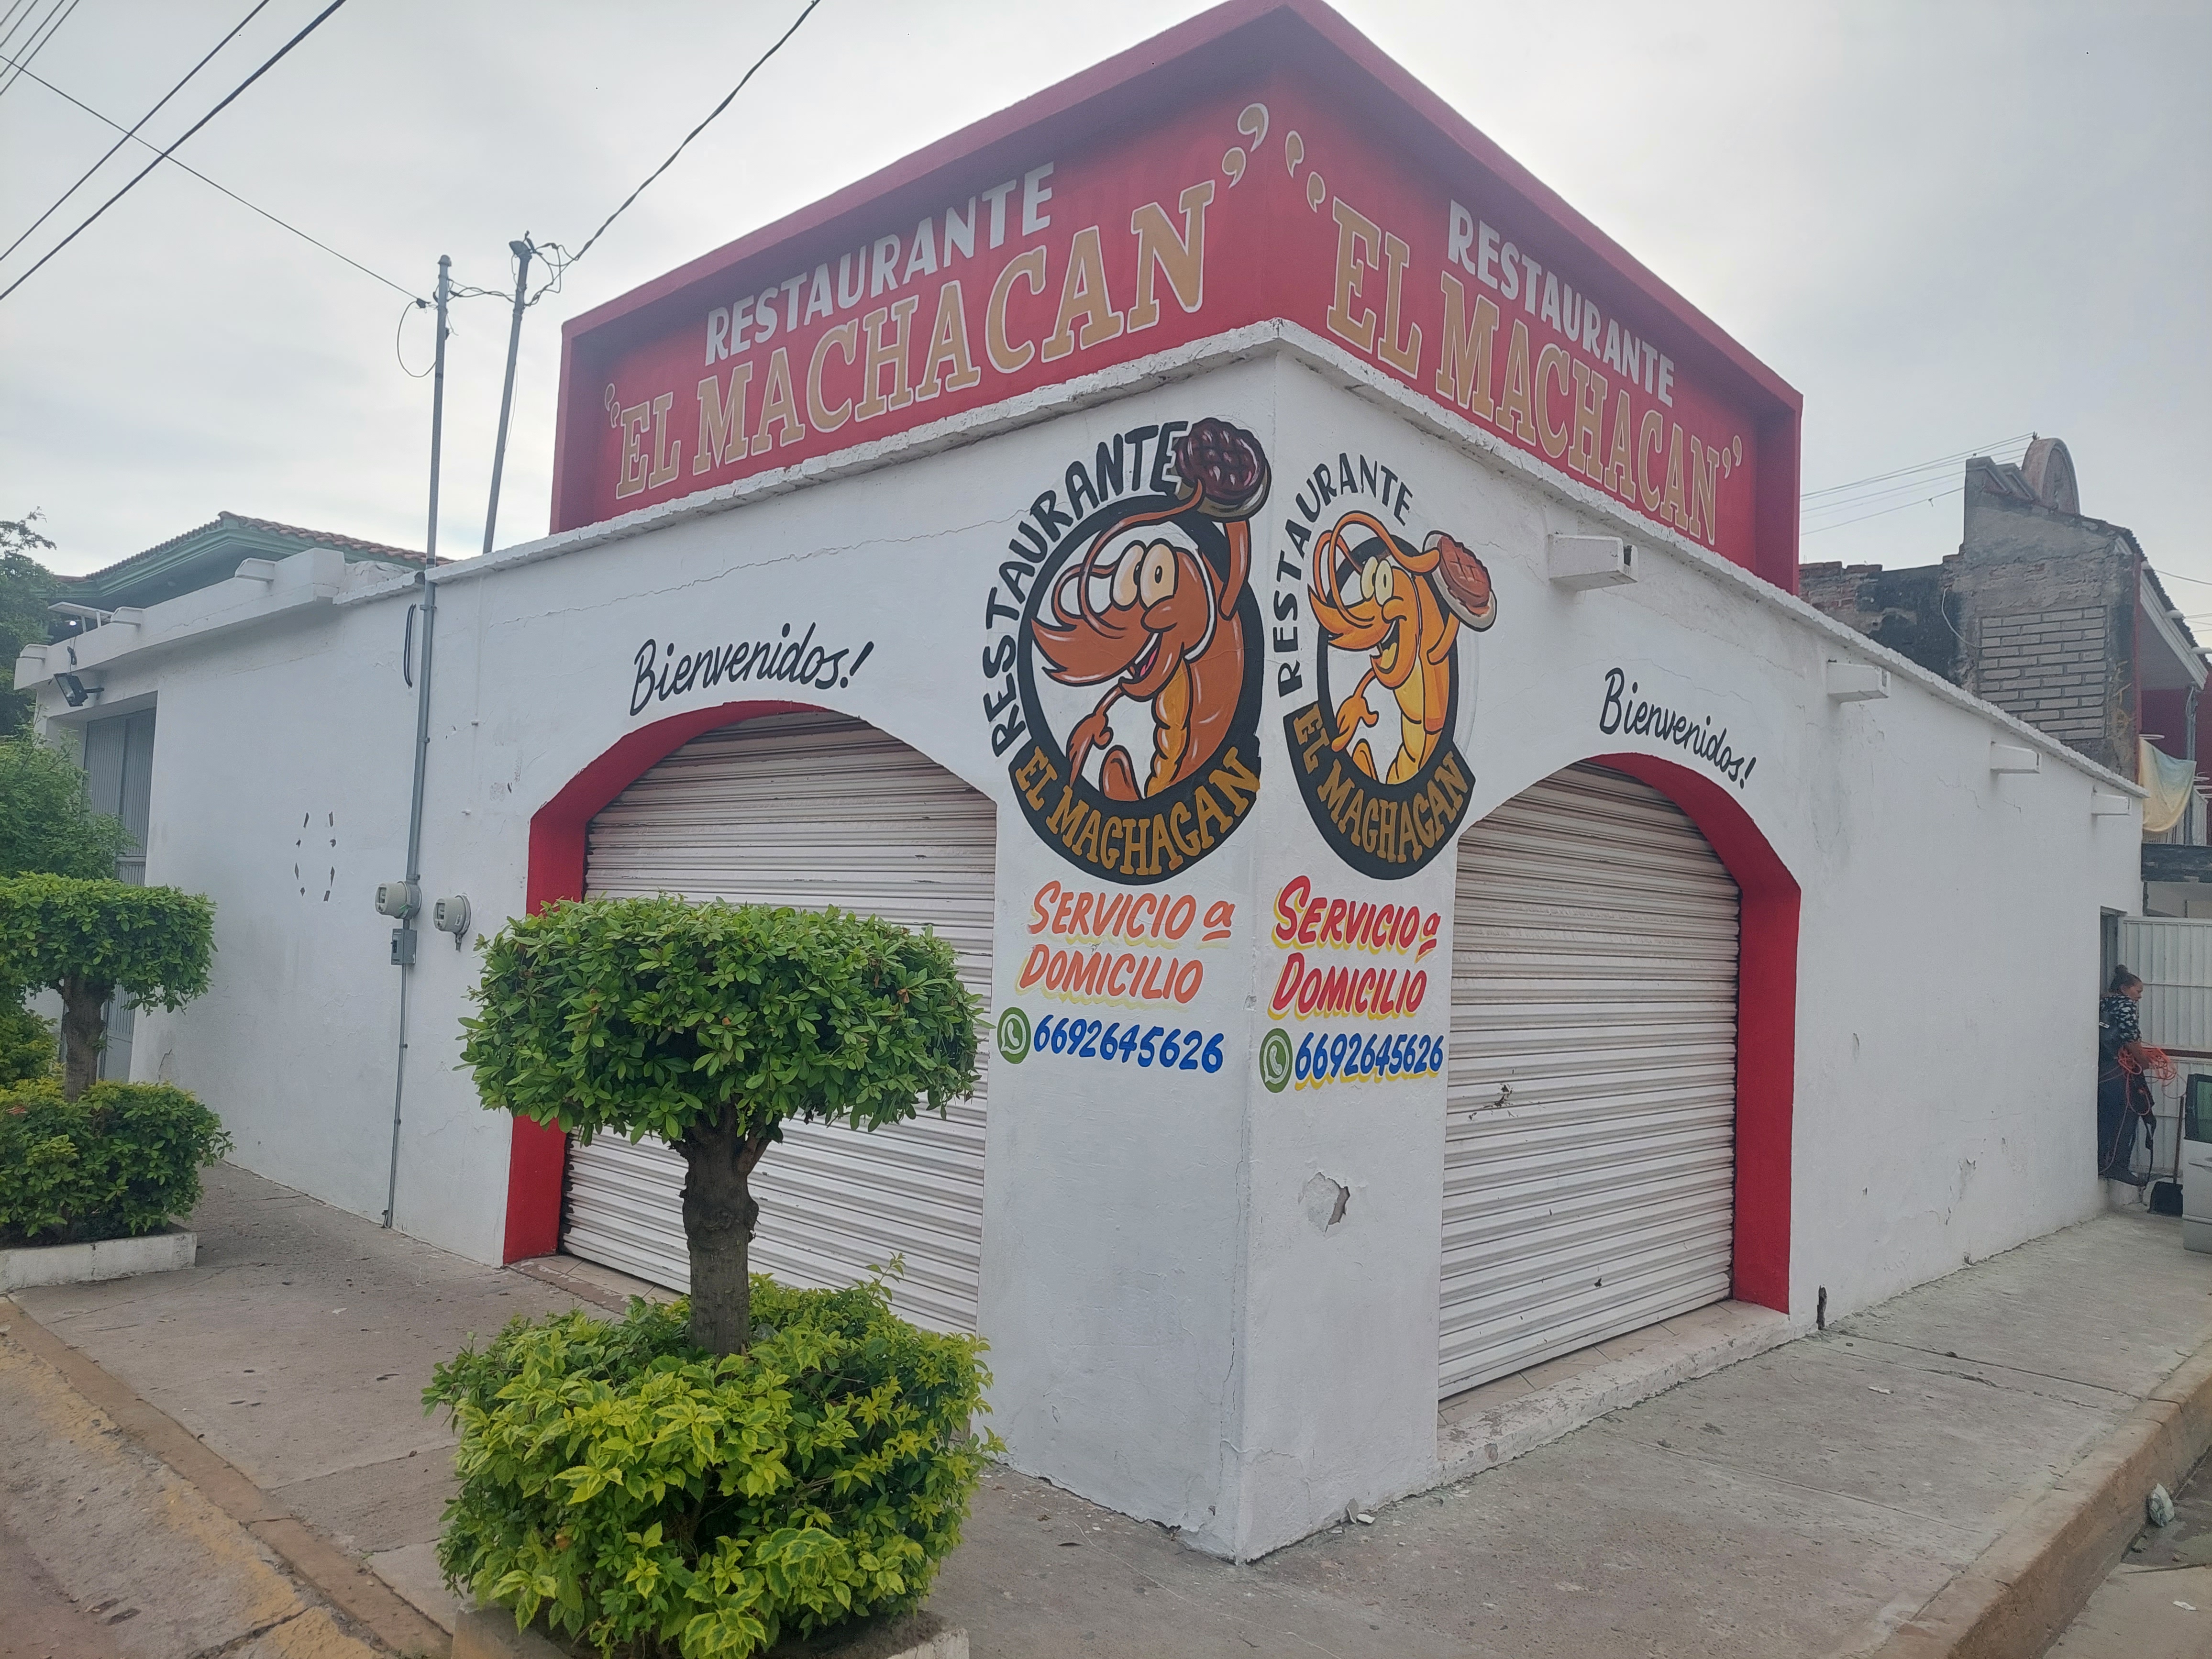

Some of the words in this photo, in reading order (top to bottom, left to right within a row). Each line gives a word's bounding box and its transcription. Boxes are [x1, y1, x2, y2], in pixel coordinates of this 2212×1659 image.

[705, 162, 1053, 366] RESTAURANTE
[1448, 199, 1675, 408] RESTAURANTE
[982, 420, 1189, 758] RESTAURANTE
[1273, 452, 1413, 697] RESTAURANTE
[630, 622, 874, 716] Bienvenidos!
[1293, 703, 1330, 774] EL
[1599, 667, 1756, 789] Bienvenidos!
[1015, 746, 1058, 811] EL
[1028, 880, 1196, 940] SERVICIO
[1274, 875, 1419, 947] SERVICIO
[1019, 944, 1203, 1003] DOMICILIO
[1272, 952, 1427, 1015] DOMICILIO
[1034, 1014, 1224, 1073] 6692645626
[1295, 1032, 1443, 1081] 6692645626
